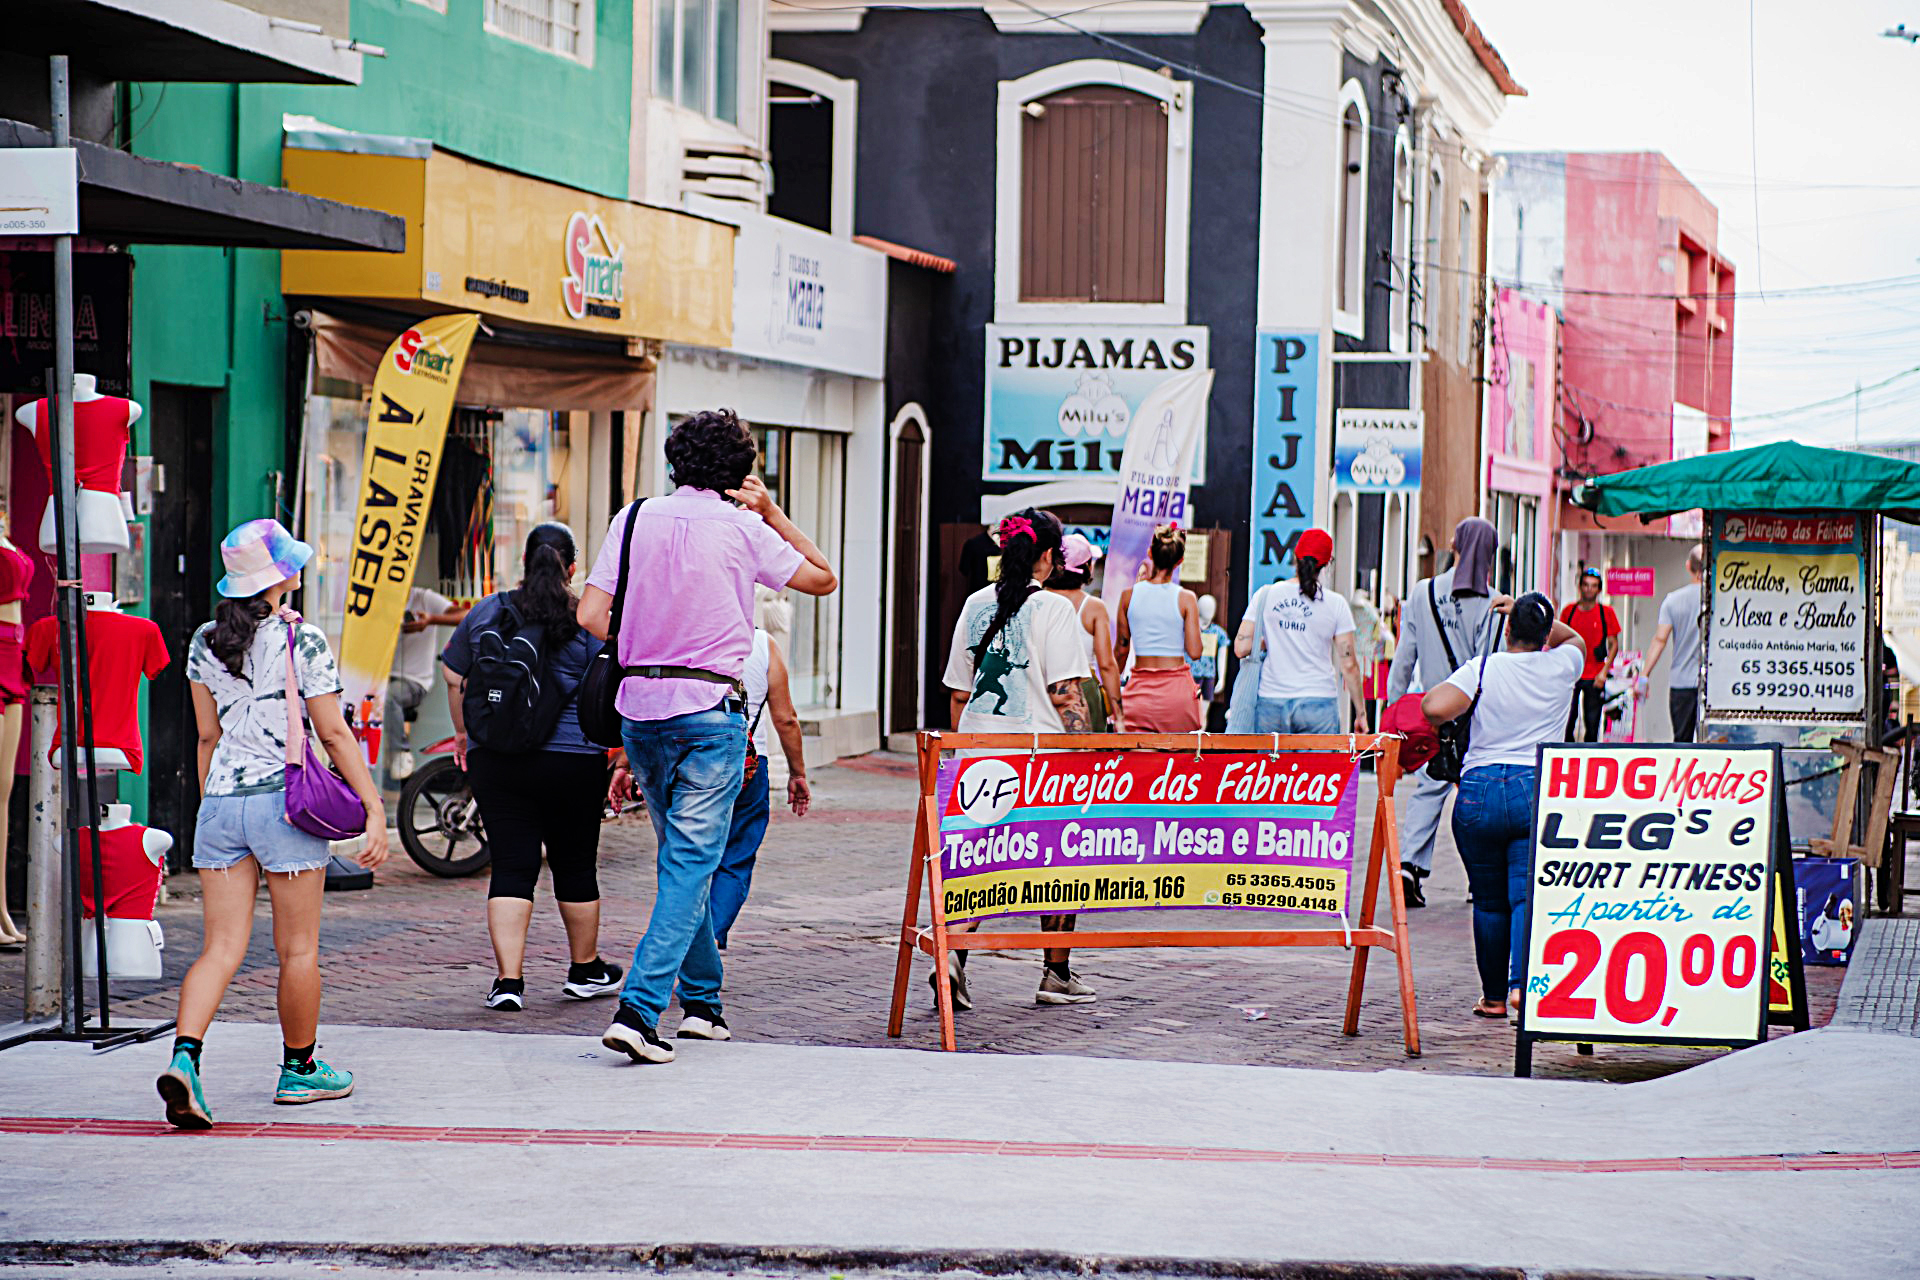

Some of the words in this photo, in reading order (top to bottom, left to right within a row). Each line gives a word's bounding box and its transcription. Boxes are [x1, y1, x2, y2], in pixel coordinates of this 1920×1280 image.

[998, 337, 1195, 370] PIJAMAS
[377, 392, 425, 427] À
[1061, 408, 1126, 424] Milu's
[1341, 419, 1419, 430] PIJAMAS
[1260, 337, 1306, 583] PIJAM
[347, 445, 408, 618] LASER
[387, 450, 432, 584] GRAVAÇÃO
[1747, 517, 1788, 544] Varejão
[1792, 521, 1811, 541] das
[1719, 560, 1789, 595] Tecidos,
[1799, 564, 1855, 595] Cama,
[1719, 597, 1772, 628] Mesa
[1779, 611, 1788, 626] e
[1794, 600, 1856, 630] Banho
[1718, 638, 1763, 651] Calçadão
[1766, 638, 1804, 651] Antônio
[1807, 641, 1838, 653] Maria,
[1840, 641, 1856, 651] 166
[1741, 660, 1761, 674] 65
[1766, 661, 1855, 676] 3365.4505
[1731, 682, 1751, 696] 65
[1756, 683, 1854, 698] 99290.4148
[1024, 758, 1134, 815] Varejão
[1149, 758, 1202, 802] das
[1216, 759, 1342, 803] Fábricas
[1547, 756, 1657, 800] HDG
[1659, 757, 1768, 808] Modas
[1061, 821, 1146, 863] Cama,
[1153, 821, 1225, 856] Mesa
[1232, 827, 1249, 851] e
[1256, 821, 1349, 860] Banho
[1729, 816, 1756, 846] e
[1226, 873, 1247, 887] 65
[1250, 874, 1336, 891] 3365.4505
[1538, 860, 1632, 888] SHORT
[1639, 862, 1765, 892] FITNESS
[944, 881, 1018, 915] Calçadão
[1021, 878, 1091, 904] Antônio
[1094, 876, 1149, 902] Maria,
[1153, 876, 1186, 899] 166
[1222, 892, 1243, 906] 65
[1246, 892, 1337, 911] 99290.4148
[1547, 892, 1586, 928] A
[1582, 891, 1693, 928] partir
[1712, 896, 1753, 920] de
[1527, 973, 1551, 997] R$
[1536, 928, 1757, 1027] 20,00
